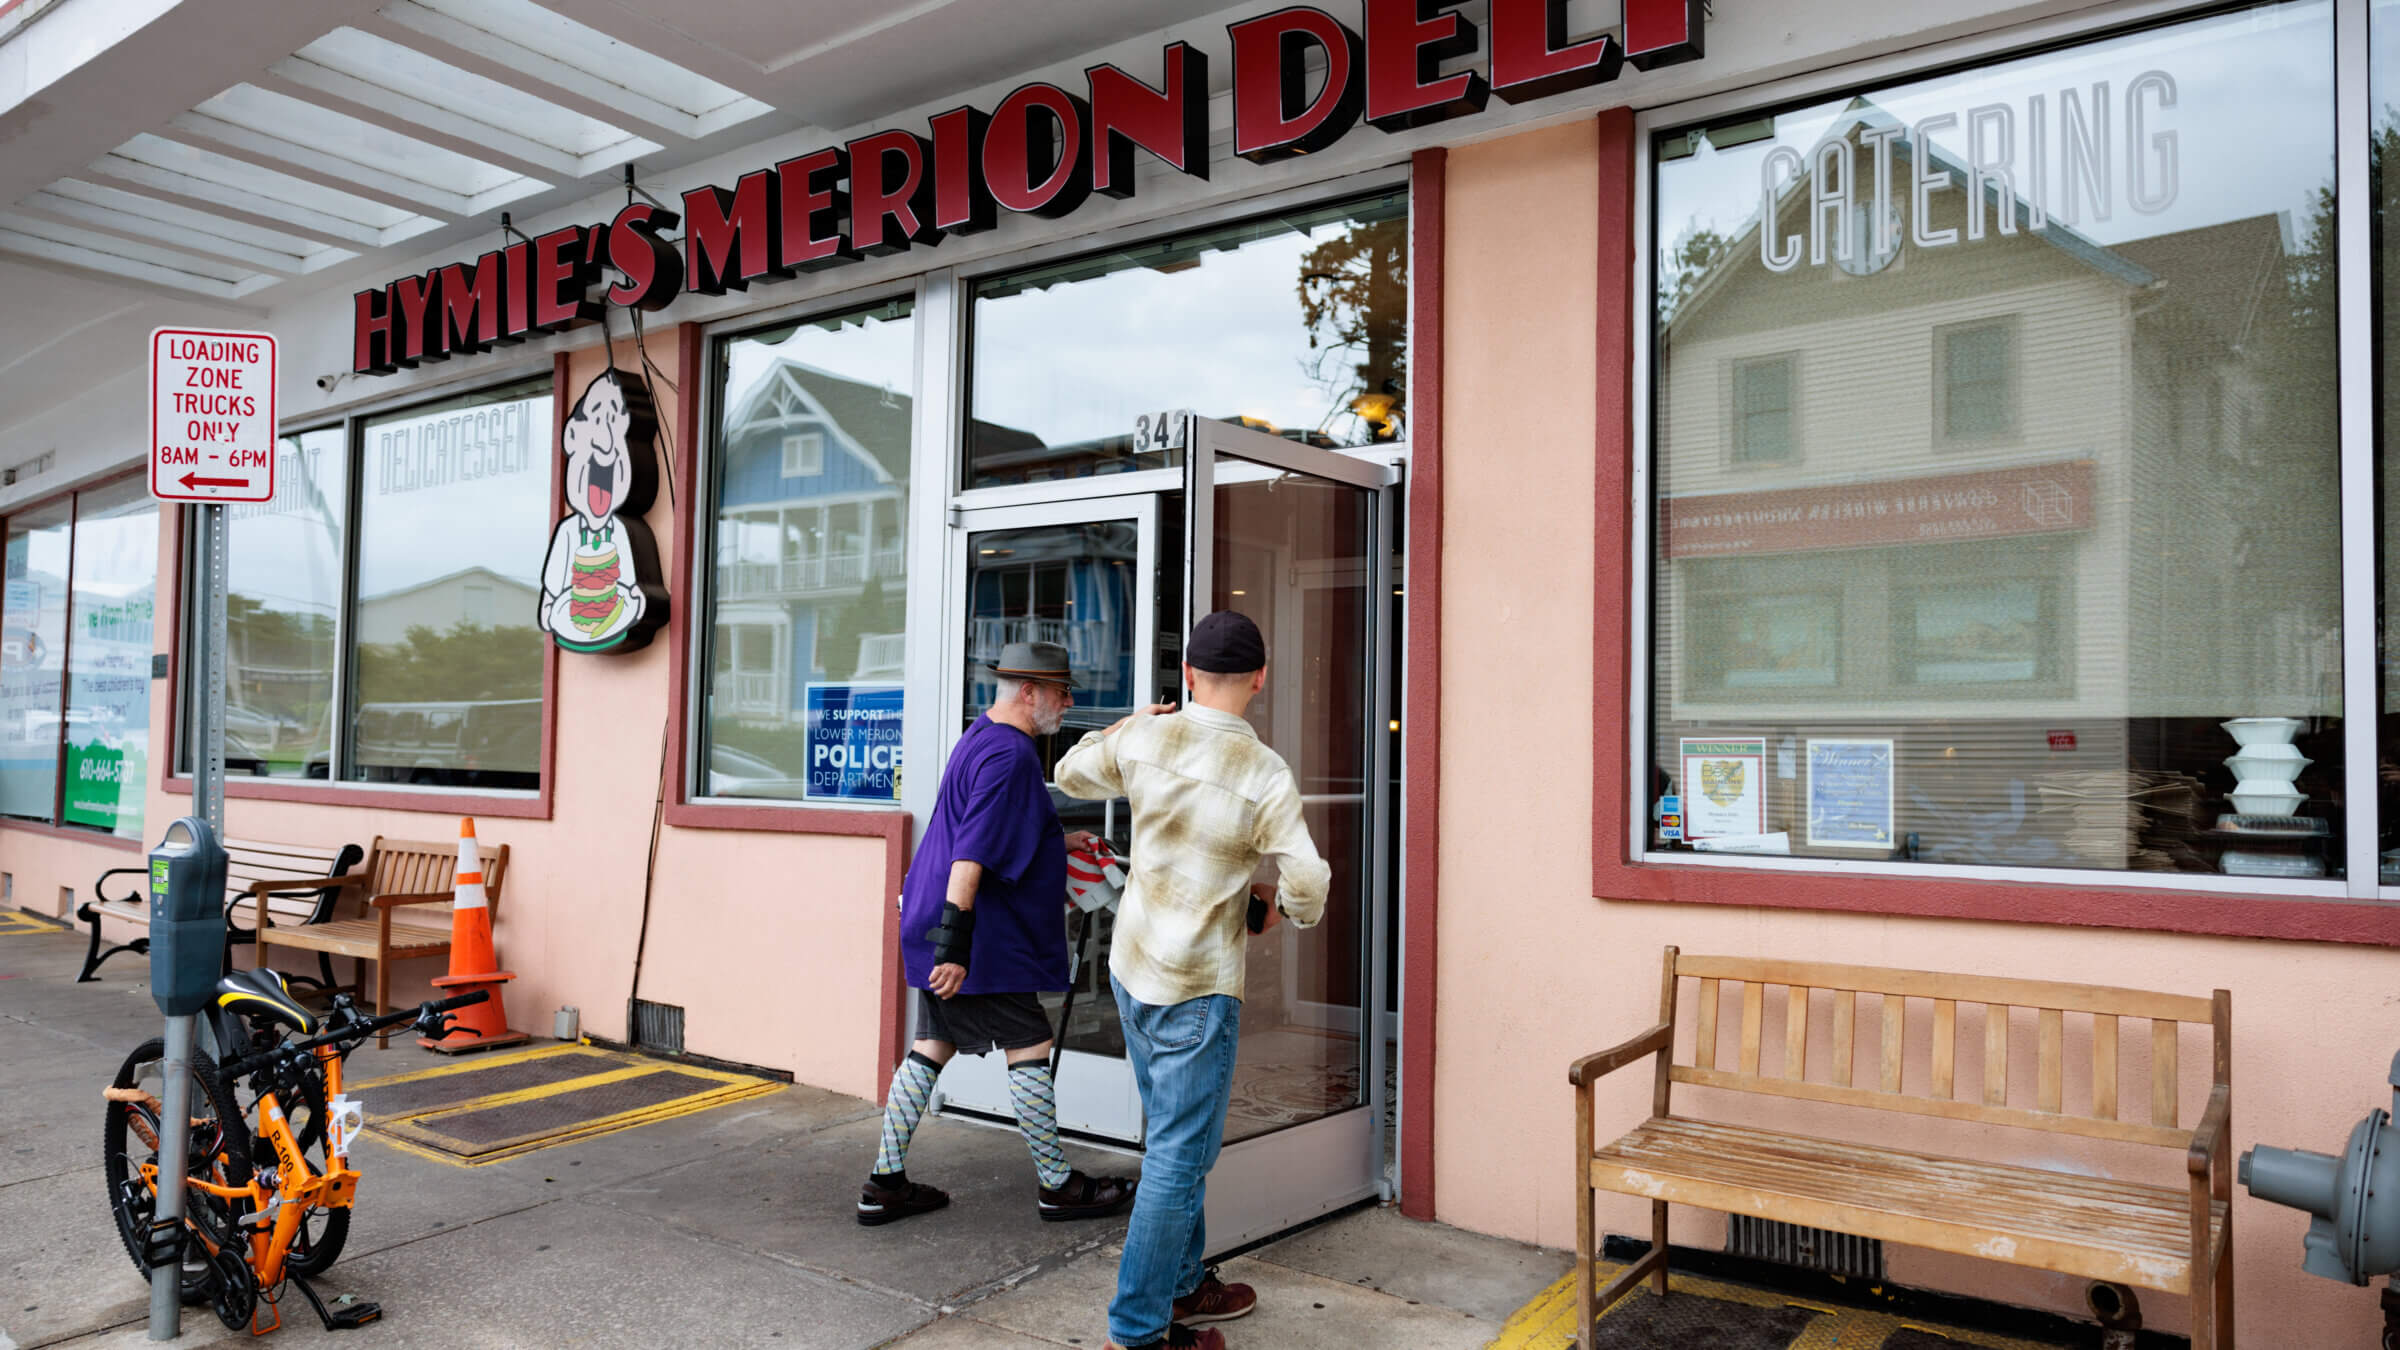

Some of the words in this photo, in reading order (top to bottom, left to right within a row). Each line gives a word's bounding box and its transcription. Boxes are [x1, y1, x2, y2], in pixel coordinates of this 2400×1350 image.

[1760, 69, 2180, 273] CATERING
[353, 202, 662, 376] HYMIE'S
[681, 39, 1196, 295] MERION
[170, 338, 260, 364] LOADING
[186, 366, 243, 390] ZONE
[173, 392, 256, 417] TRUCKS
[161, 445, 199, 465] 8AM
[229, 449, 267, 469] 6PM
[379, 401, 531, 496] DELICATESSEN
[815, 709, 831, 721] WE
[833, 709, 884, 721] SUPPORT
[814, 727, 855, 741] LOWER
[858, 728, 903, 742] MERION
[814, 743, 904, 770] POLICE
[1695, 743, 1749, 753] WINNER
[814, 770, 894, 789] DEPARTMEN
[1663, 829, 1680, 837] VISA
[271, 1128, 295, 1174] R-100
